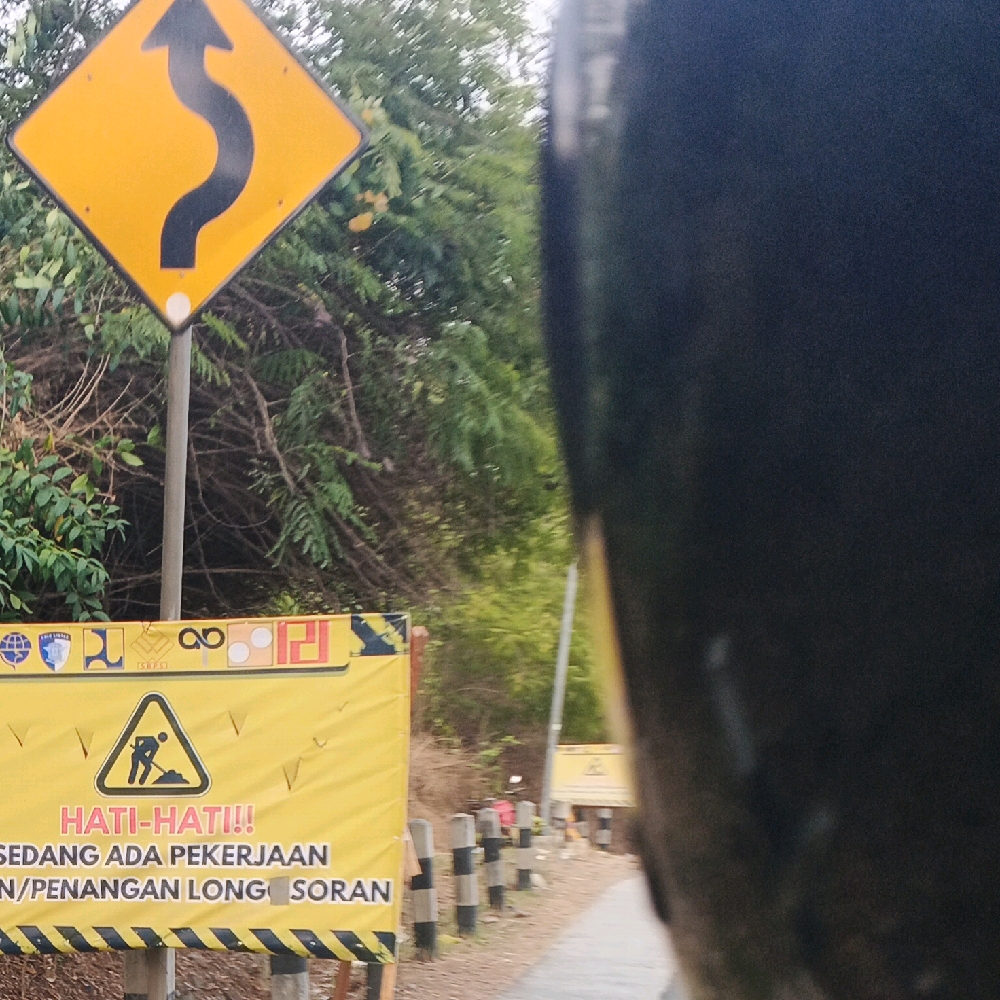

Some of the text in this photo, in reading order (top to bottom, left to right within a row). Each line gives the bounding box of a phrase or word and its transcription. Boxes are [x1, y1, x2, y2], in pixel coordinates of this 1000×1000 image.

[61, 805, 255, 835] HATI-HATI!!
[104, 844, 163, 867] ADA
[170, 844, 328, 867] PEKERJAAN
